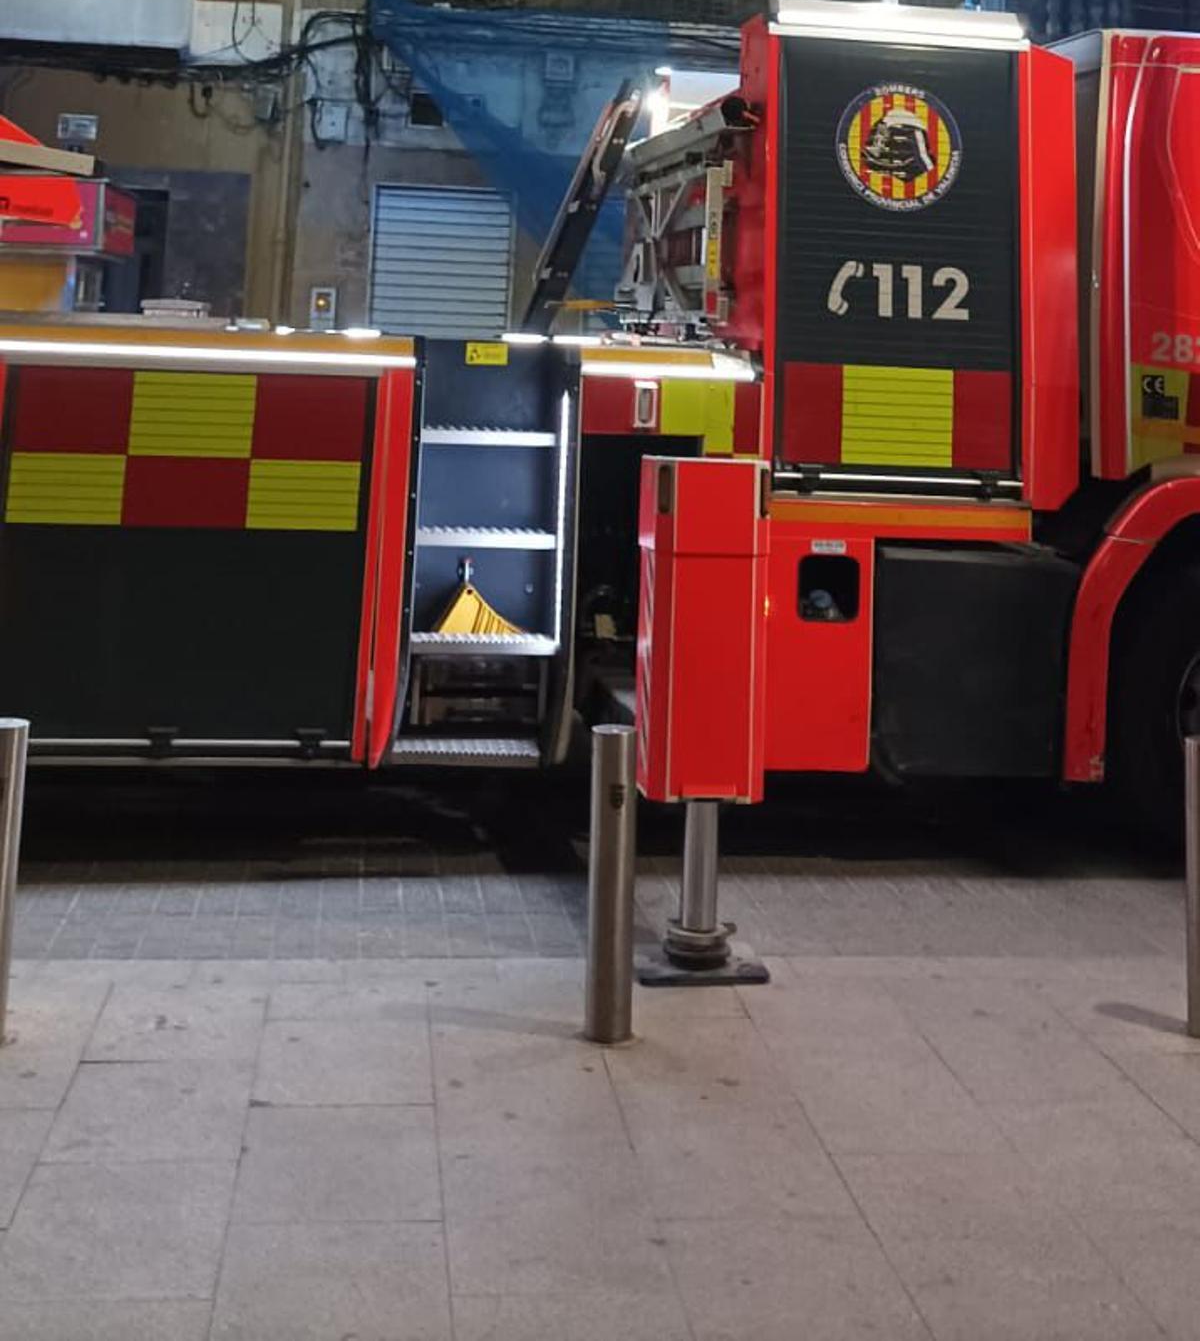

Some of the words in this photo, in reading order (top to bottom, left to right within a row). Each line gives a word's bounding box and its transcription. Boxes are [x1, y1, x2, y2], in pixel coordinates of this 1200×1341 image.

[872, 262, 970, 321] 112
[1151, 332, 1200, 365] 28
[1143, 376, 1165, 394] CE
